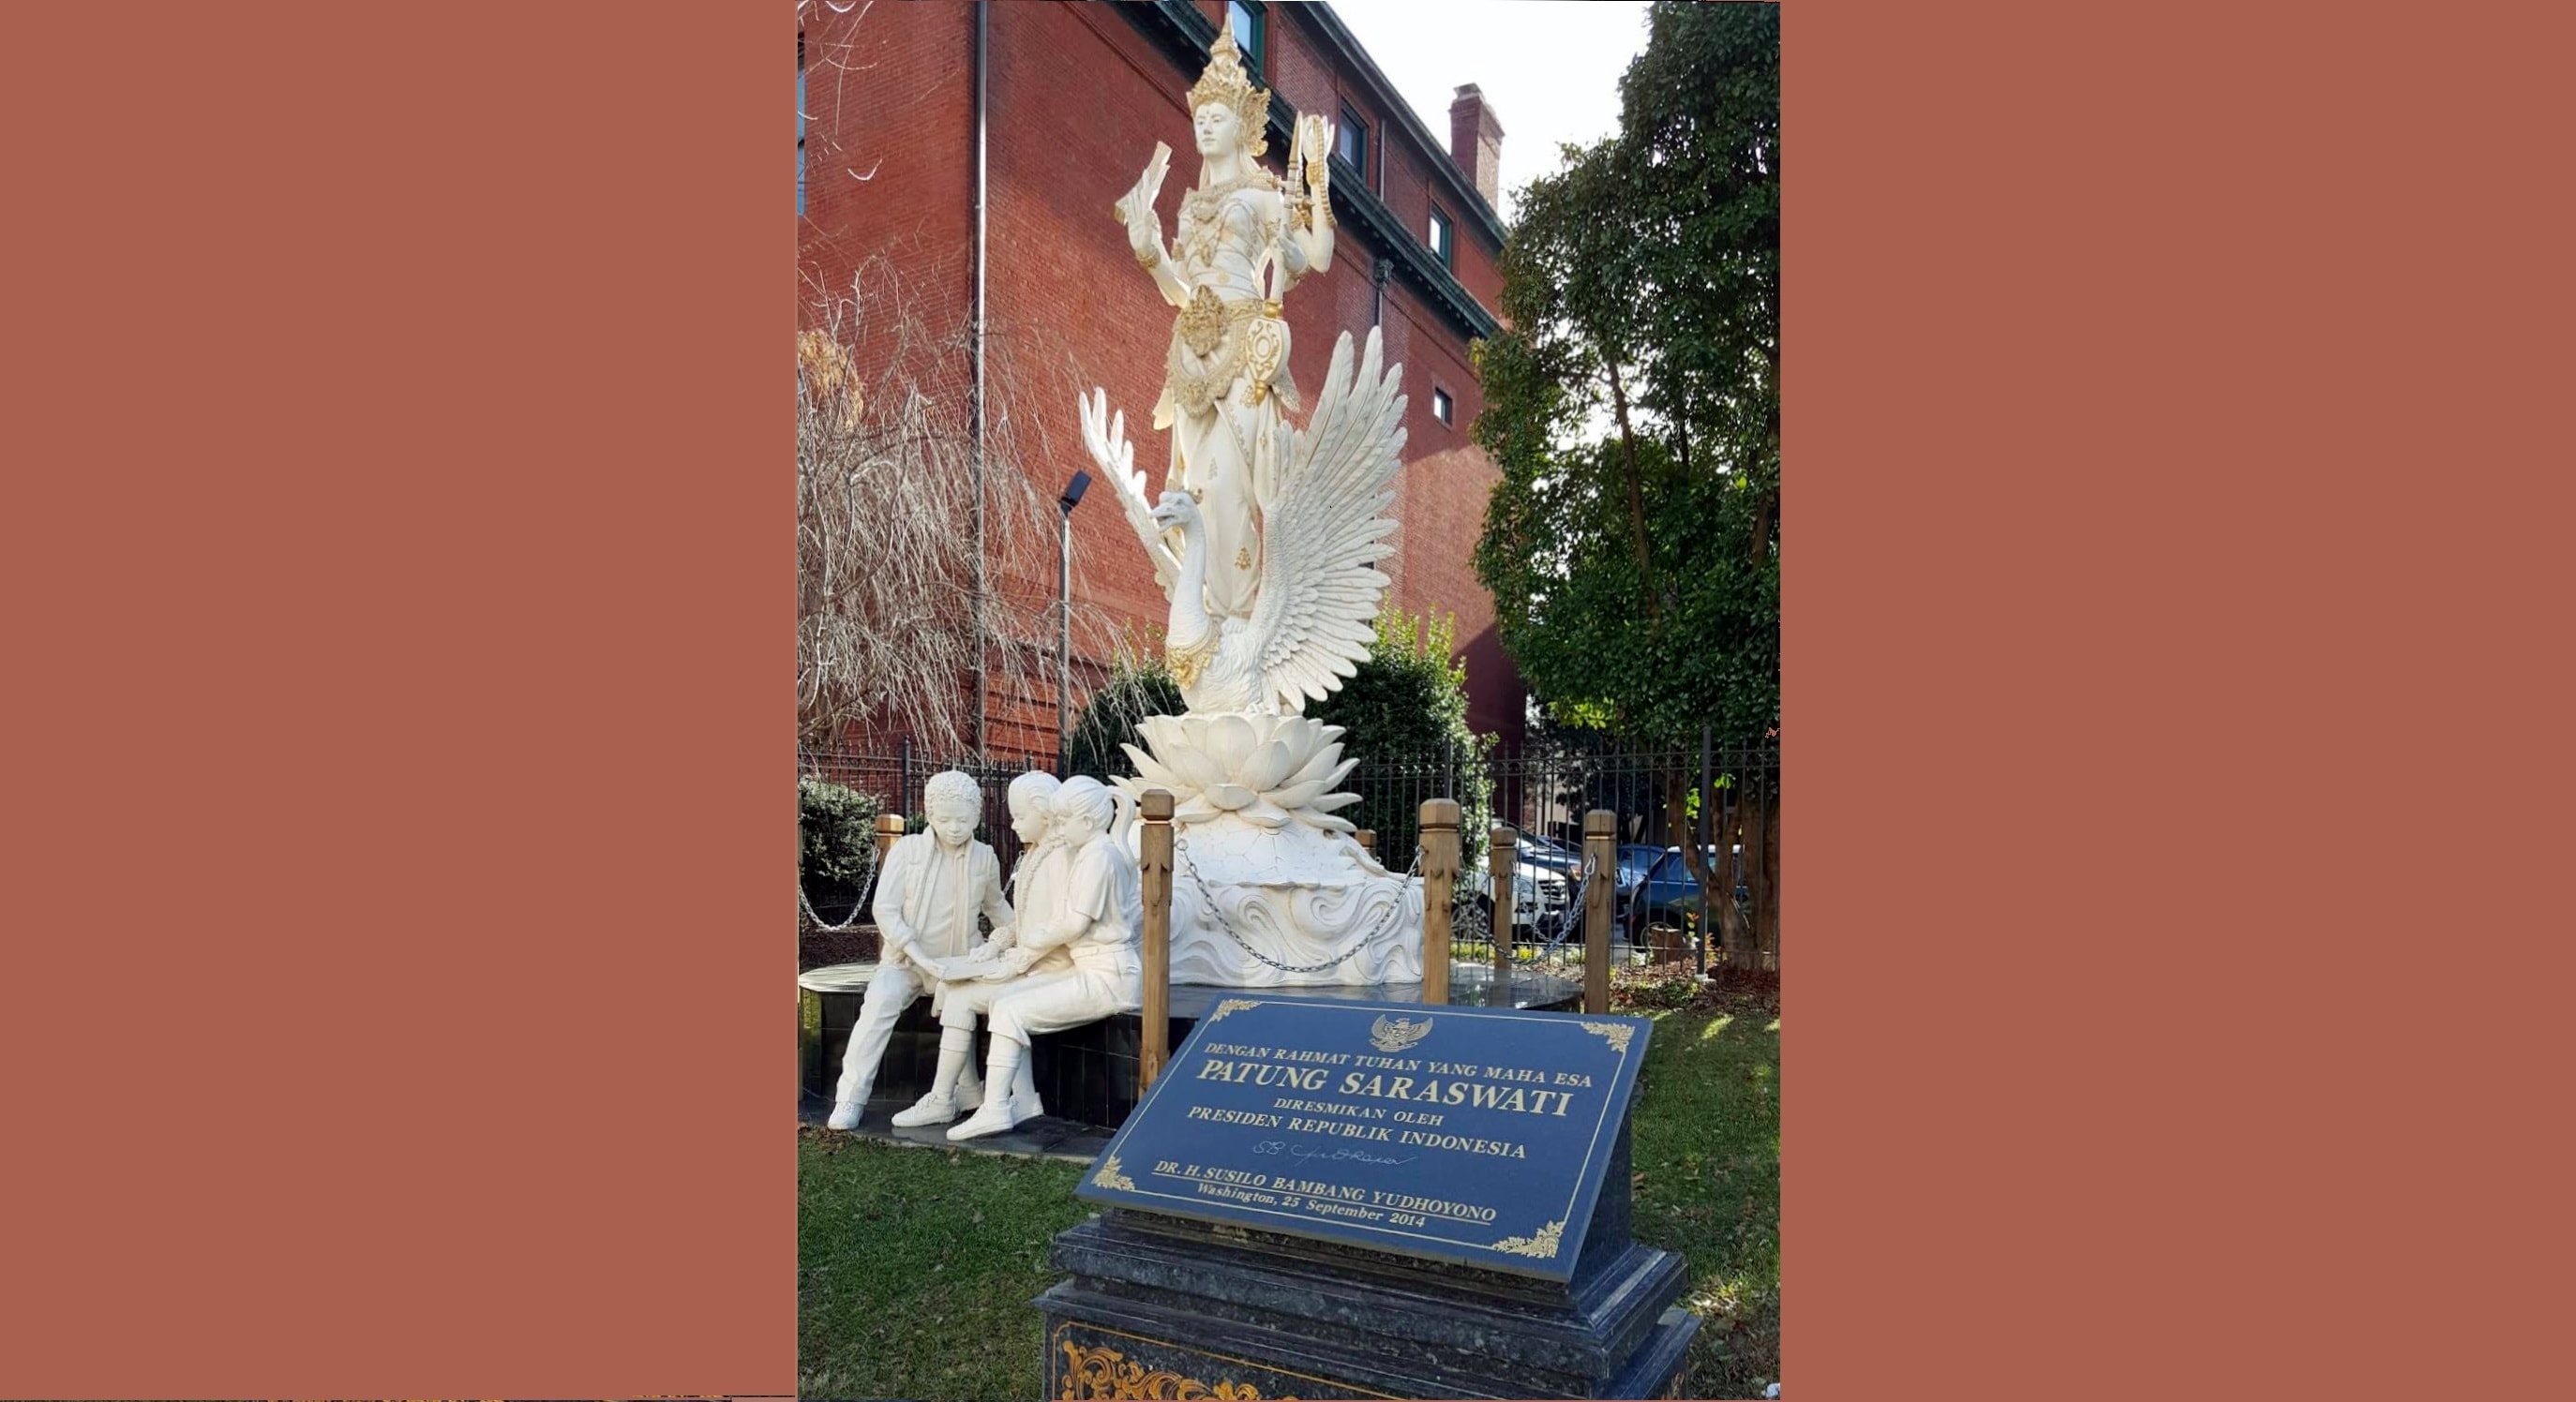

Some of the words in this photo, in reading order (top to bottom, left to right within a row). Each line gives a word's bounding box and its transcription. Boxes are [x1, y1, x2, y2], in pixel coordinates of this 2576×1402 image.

[1196, 1059, 1329, 1091] PATUNG
[1339, 1072, 1574, 1117] SARASWATI
[1205, 1042, 1271, 1058] DENGAN
[1273, 1049, 1351, 1065] RAHMAT
[1354, 1055, 1421, 1071] TUHAN
[1428, 1061, 1478, 1077] YANG
[1483, 1066, 1546, 1083] MAHA
[1553, 1072, 1593, 1088] ESA
[1187, 1106, 1283, 1128] PRESIDEN
[1287, 1117, 1393, 1141] REPUBLIK
[1399, 1130, 1527, 1159] INDONESIA
[1273, 1097, 1386, 1120] DIRESMIKAN
[1393, 1111, 1445, 1126] OLEH
[1154, 1160, 1181, 1174] DR.
[1184, 1165, 1201, 1177] H.
[1204, 1167, 1267, 1186] SUSILO
[1271, 1177, 1366, 1201] BAMBANG
[1371, 1191, 1497, 1221] YUDHOYONO
[1197, 1183, 1278, 1206] Washington,
[1281, 1196, 1301, 1208] 25
[1306, 1200, 1384, 1220] September
[1389, 1212, 1427, 1228] 2014
